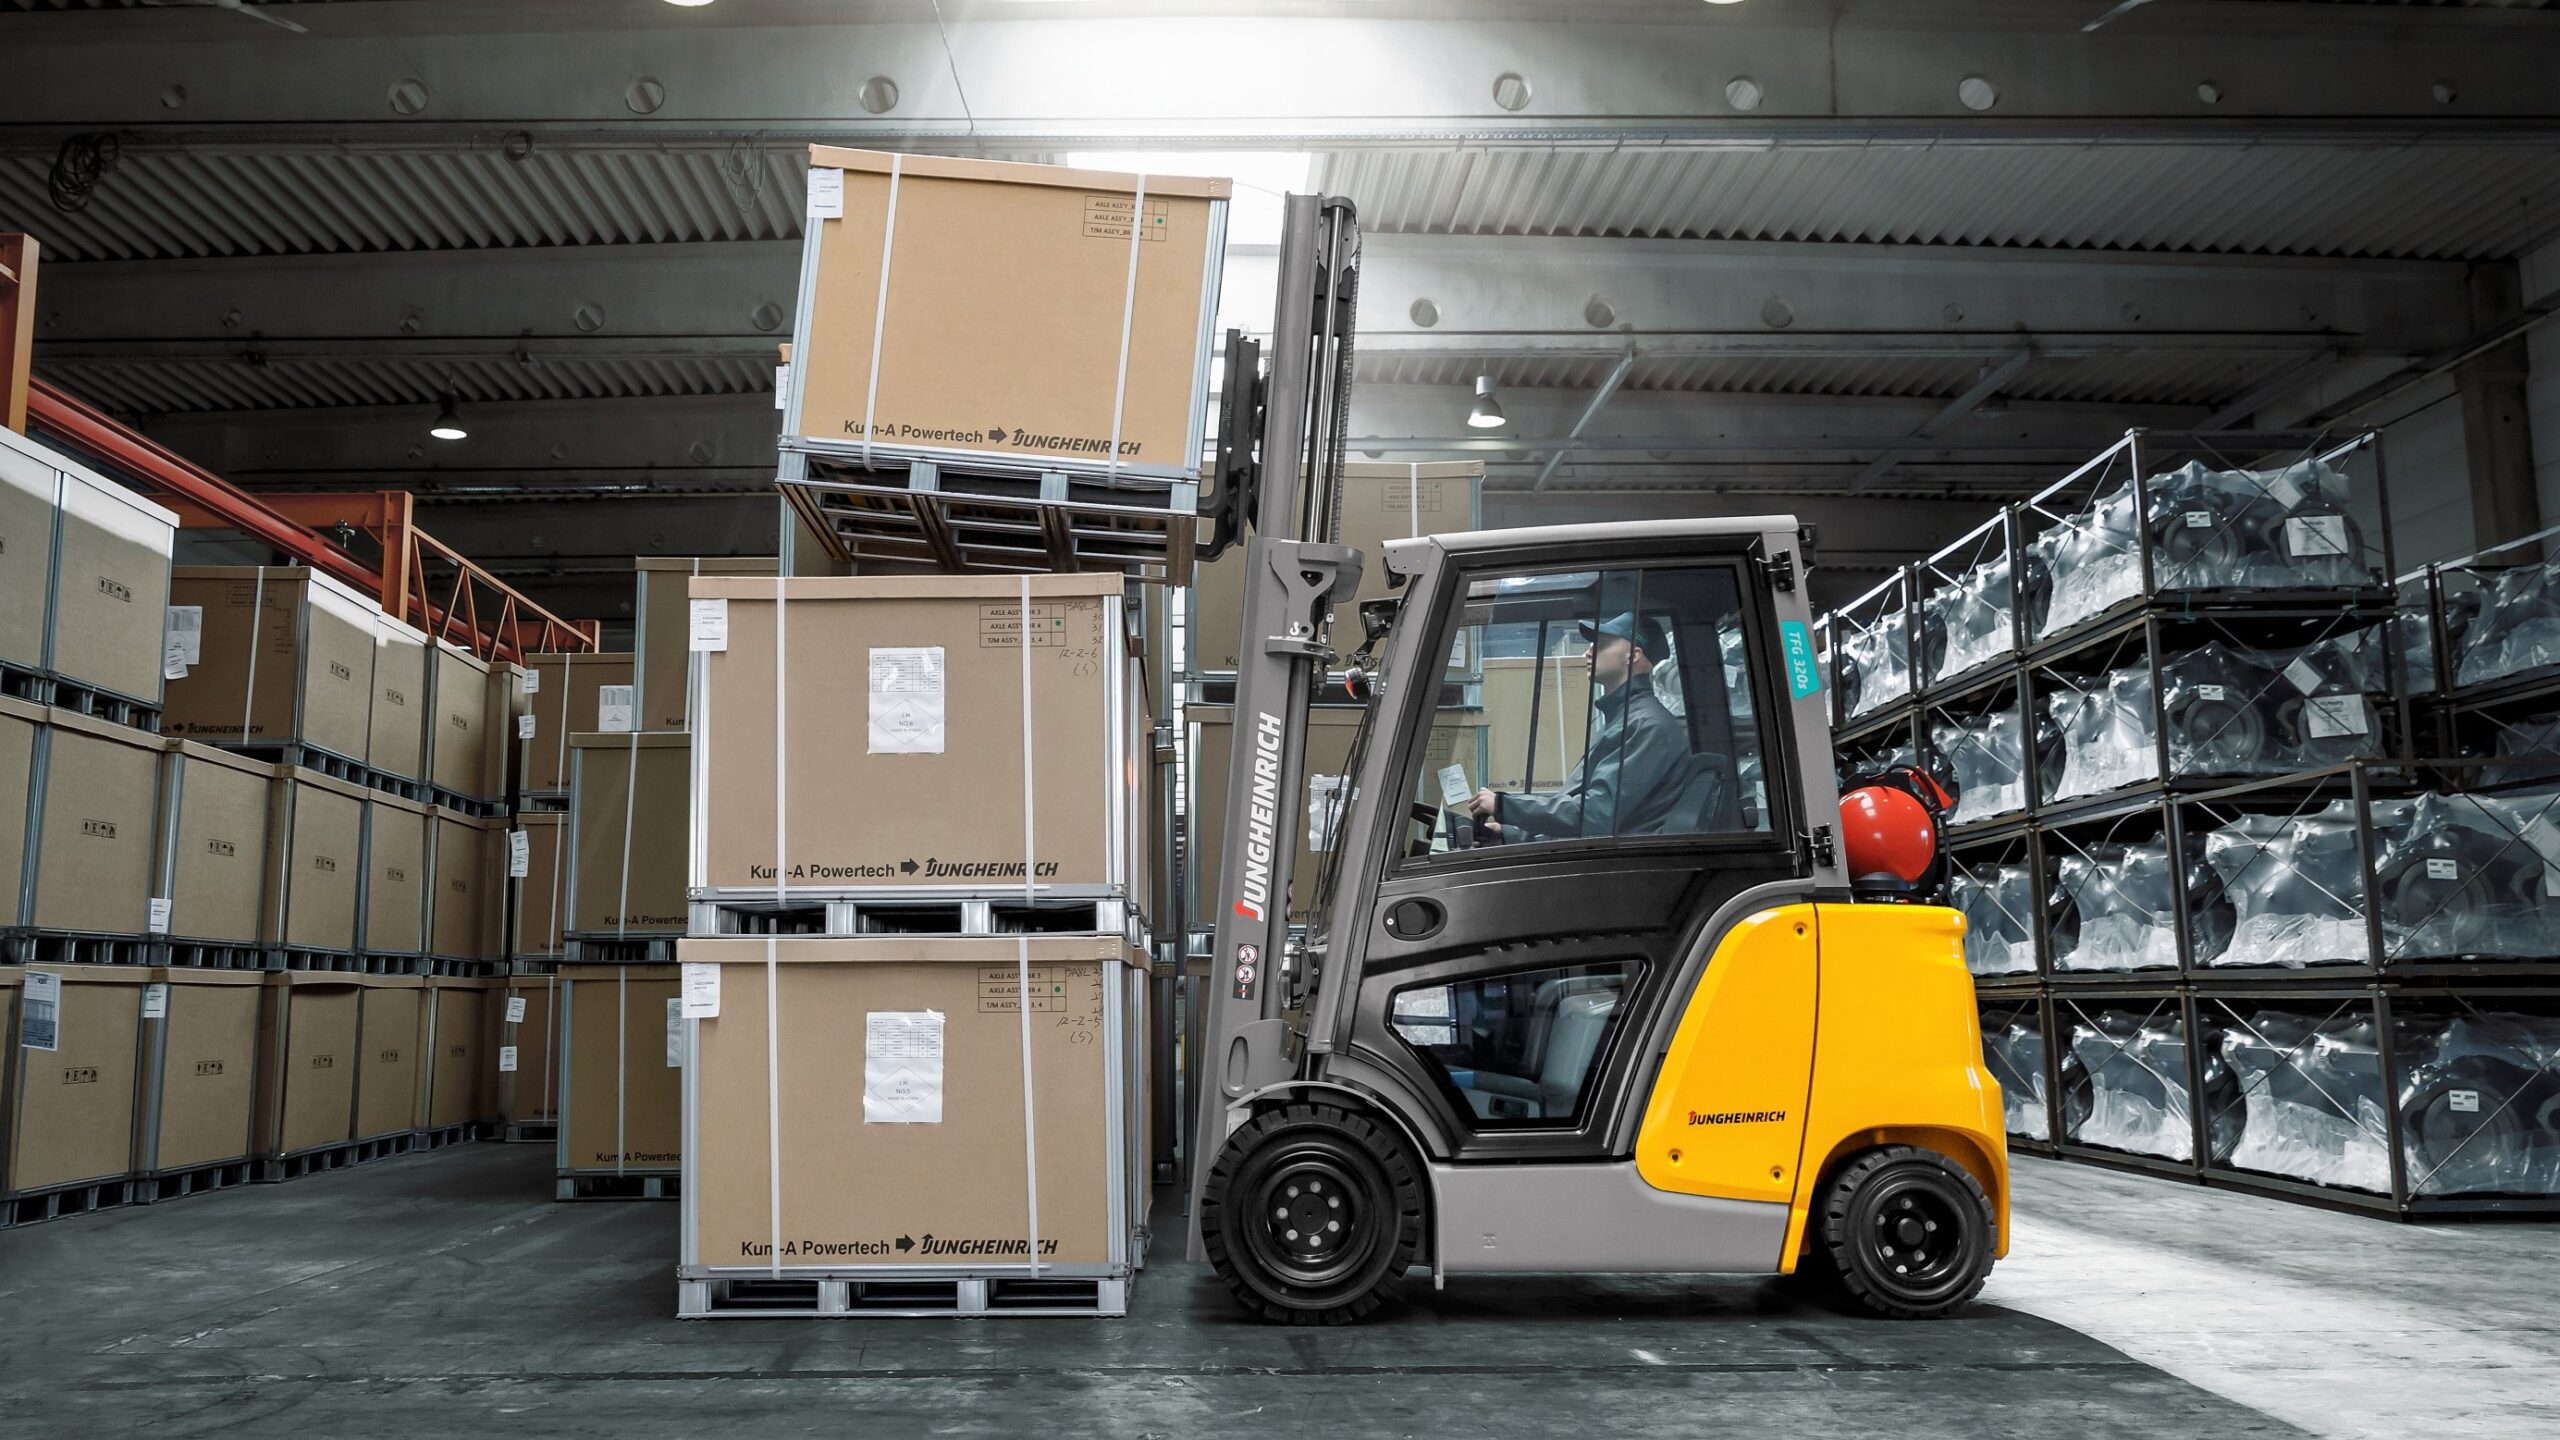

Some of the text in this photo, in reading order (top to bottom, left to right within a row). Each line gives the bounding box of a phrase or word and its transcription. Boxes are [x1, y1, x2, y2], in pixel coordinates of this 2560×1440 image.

[901, 424, 983, 443] Powertech
[1012, 428, 1142, 455] JUNGHEINRCH
[1788, 631, 1809, 690] TFG 320s
[187, 722, 264, 734] JUNGHEINRCH
[1233, 711, 1281, 922] JUNGHEINRICH
[810, 864, 895, 879] Powertech
[925, 857, 1059, 878] JUNGHEINRCH
[1688, 1110, 1786, 1126] JUNGHEINRICH
[596, 1152, 631, 1162] KumA
[802, 1240, 890, 1256] Powertech
